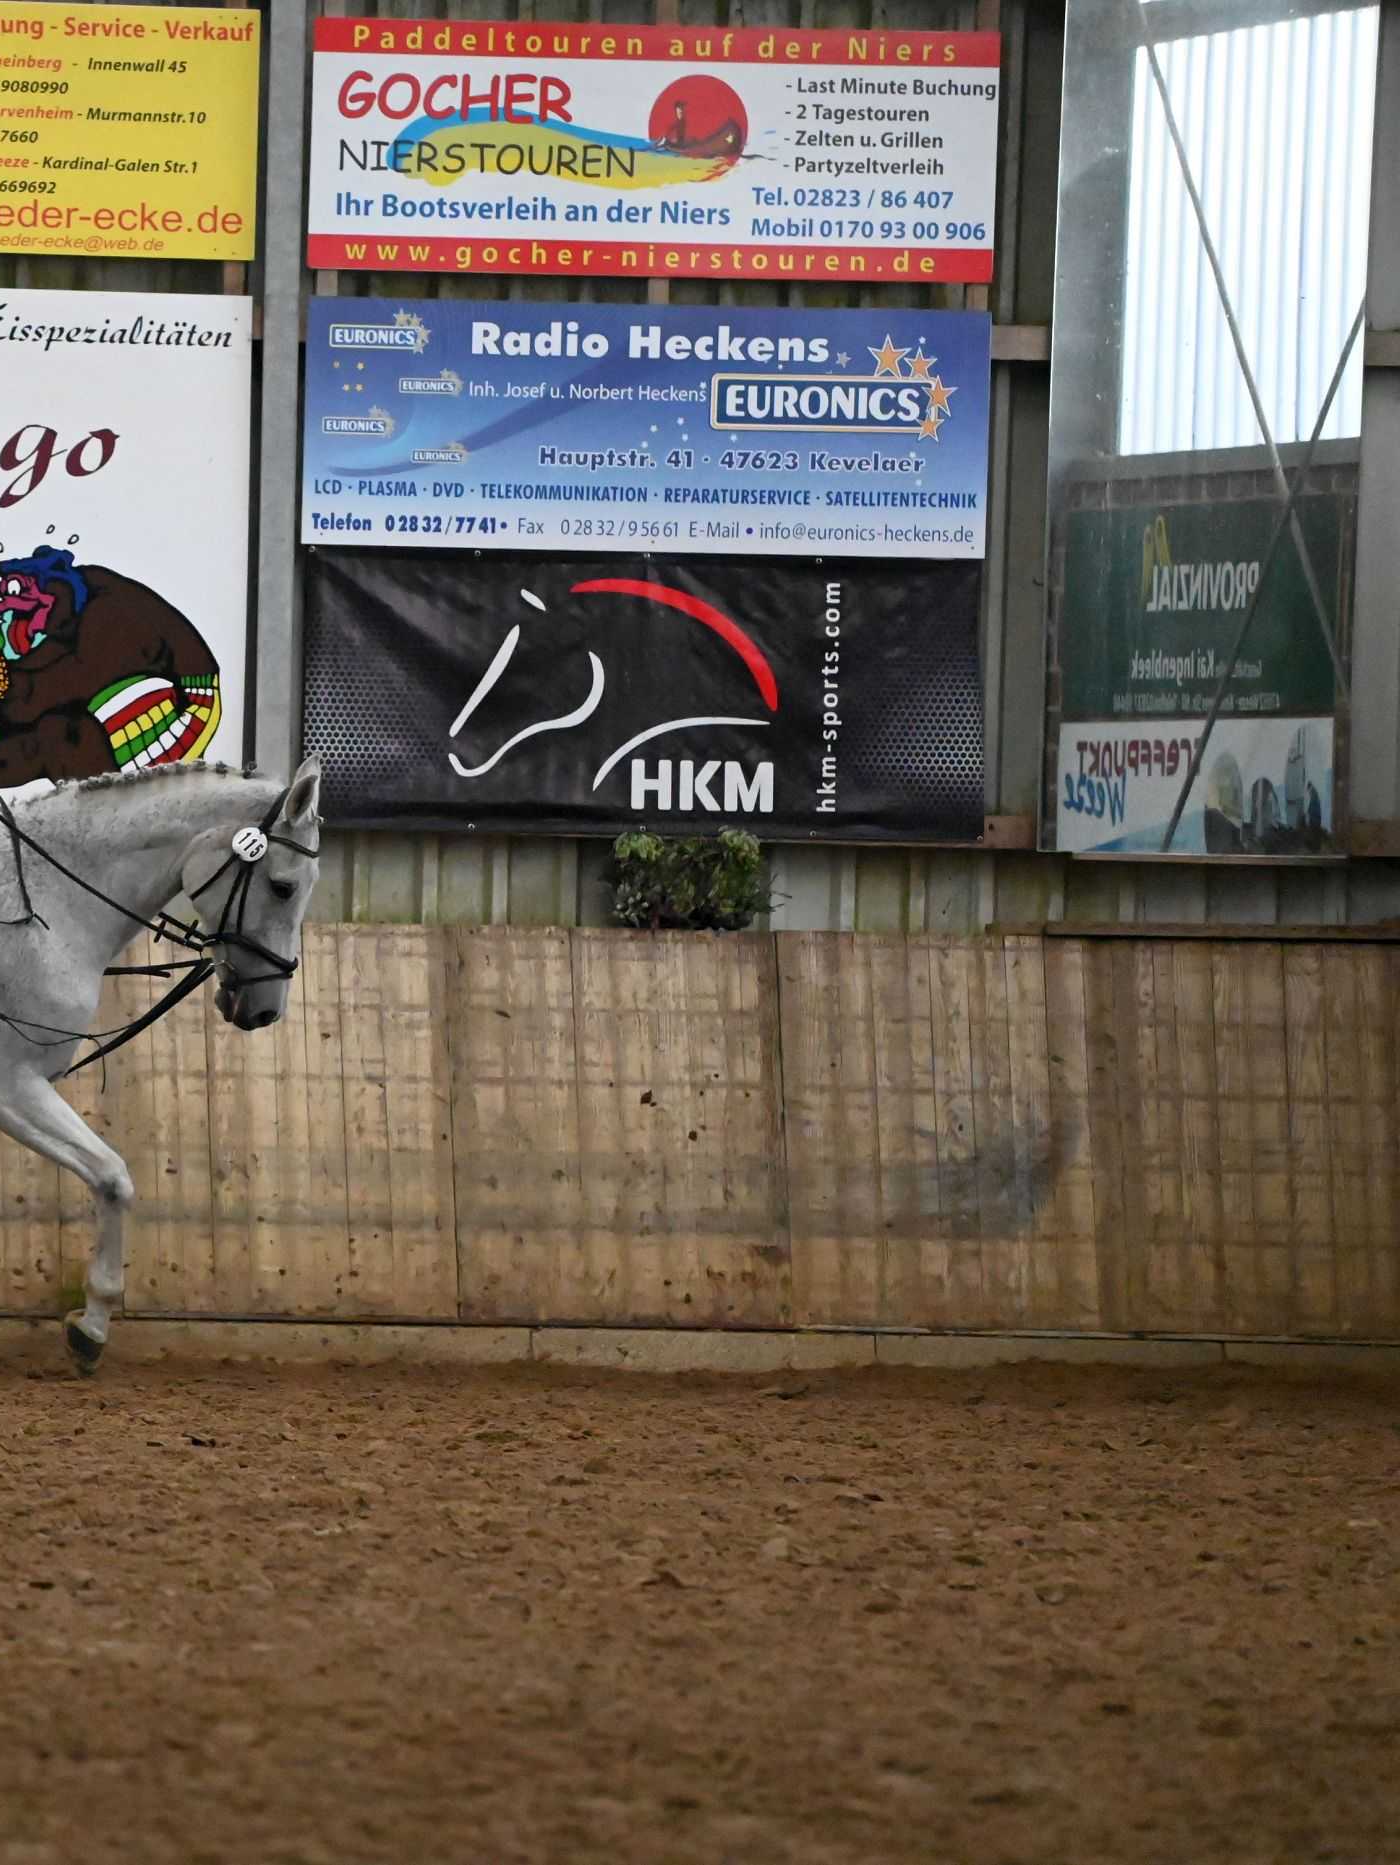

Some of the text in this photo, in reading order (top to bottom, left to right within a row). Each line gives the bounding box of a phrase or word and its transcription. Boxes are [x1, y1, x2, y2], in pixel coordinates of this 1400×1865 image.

[64, 17, 145, 39] Service
[166, 20, 254, 43] Verkauf
[353, 25, 957, 62] Paddeltouren auf der Niers
[88, 57, 165, 73] Innenwall
[168, 60, 187, 73] 45
[1, 79, 69, 94] 9080990
[338, 70, 573, 123] GOCHER
[797, 77, 835, 94] Last
[840, 78, 908, 95] Minute
[913, 80, 997, 101] Buchung
[796, 104, 807, 119] 2
[812, 104, 929, 124] Tagestouren
[0, 129, 38, 144] 7660
[794, 130, 854, 147] Zelten
[860, 135, 877, 148] u.
[881, 131, 943, 149] Grillen
[42, 155, 160, 172] Kardinal-Galen
[339, 139, 636, 180] NIERSTOUREN
[794, 157, 944, 177] Partyzeltverleih
[335, 192, 731, 226] Ihr Bootsverleih an der Niers
[752, 186, 788, 206] Tel.
[793, 188, 861, 208] 02823
[880, 190, 908, 209] 86
[913, 191, 954, 209] 407
[751, 217, 986, 241] Mobil 0170 93 00 906
[345, 243, 935, 274] www.gocher-nierstouren.de
[333, 327, 416, 346] EURONICS
[471, 321, 830, 363] Radio Heckens
[402, 380, 455, 392] EURONICS
[468, 380, 707, 403] Inh. Josef u. Norbert Heckens
[725, 384, 920, 422] EURONICS
[325, 419, 385, 432] EURONICS
[413, 451, 461, 462] EURONICS
[538, 445, 926, 474] Hauptstr. 41 47623 Kevelaer
[314, 479, 977, 509] LCD PLASMA DVD TELEKOMMUNIKATION REPARATURSERVICE SATELLITENTECHNIK
[311, 512, 372, 531] Telefon
[517, 517, 545, 535] Fax
[689, 521, 740, 539] E-Mail
[760, 522, 974, 543] info@euronics-heckens.de
[816, 582, 843, 813] hkm-sports.com
[631, 758, 774, 813] HKM
[238, 832, 264, 858] 115
